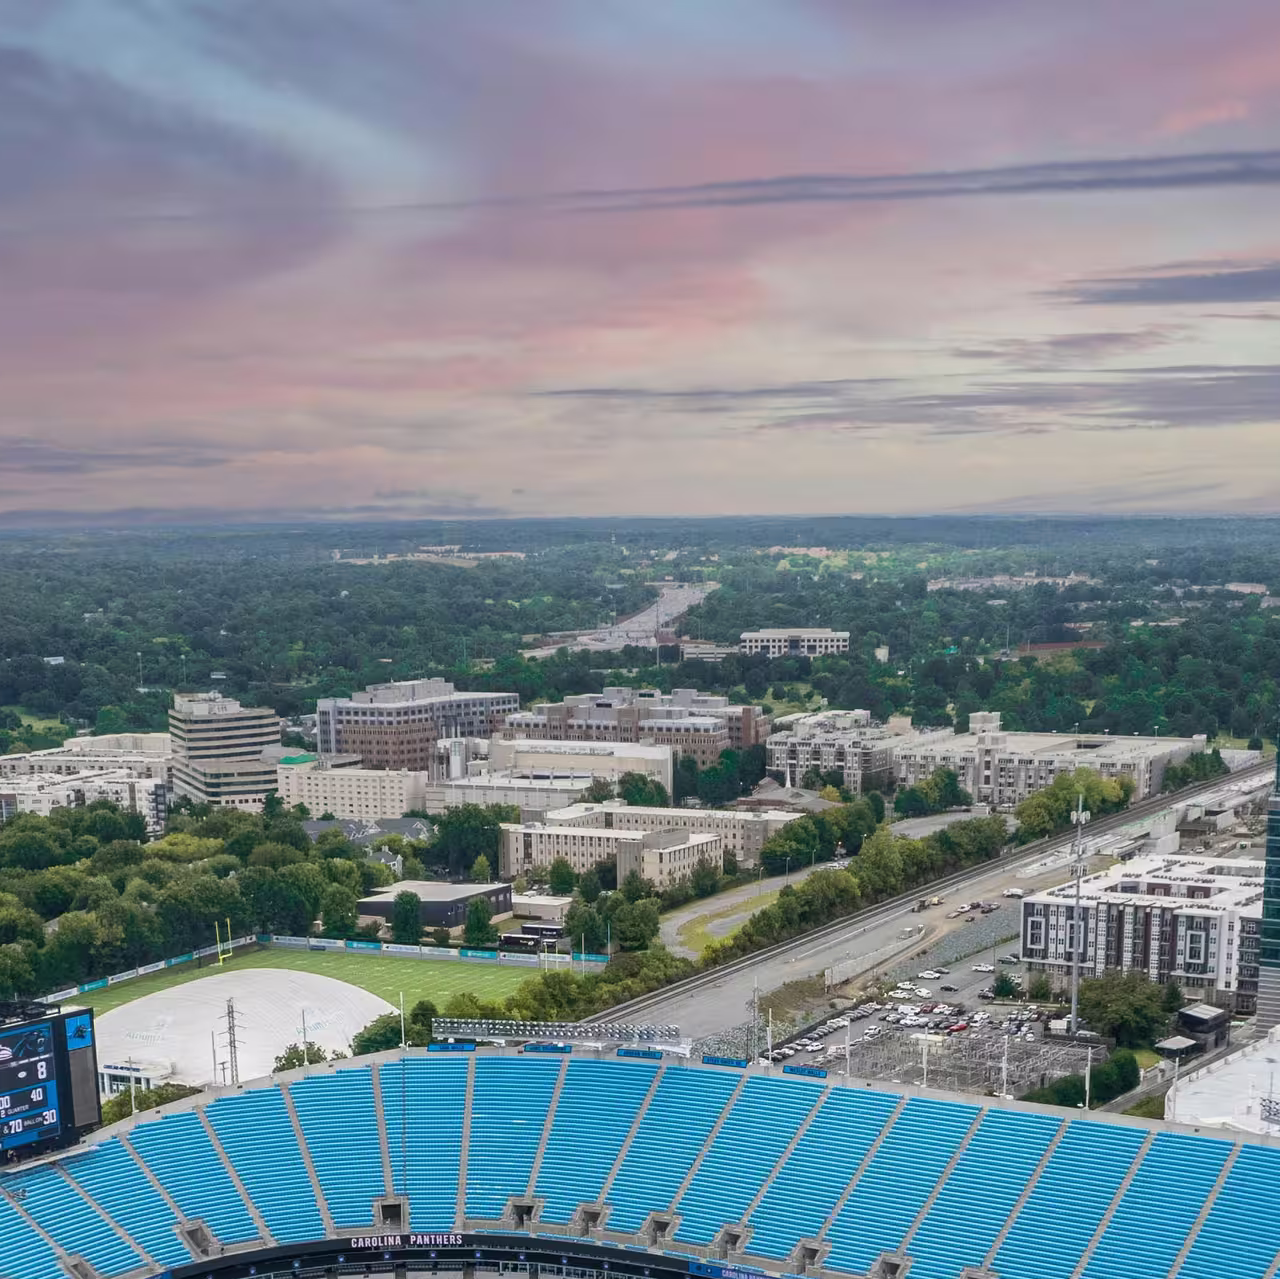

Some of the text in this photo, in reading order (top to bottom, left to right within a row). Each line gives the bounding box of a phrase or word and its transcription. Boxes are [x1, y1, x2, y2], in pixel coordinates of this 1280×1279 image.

[37, 1061, 47, 1079] 8
[30, 1088, 43, 1101] 40
[0, 1104, 29, 1118] 2 QUARTER
[3, 1126, 9, 1134] &
[9, 1119, 22, 1133] 70
[42, 1109, 56, 1125] 30
[351, 1235, 462, 1248] CAROLINA PANTHERS
